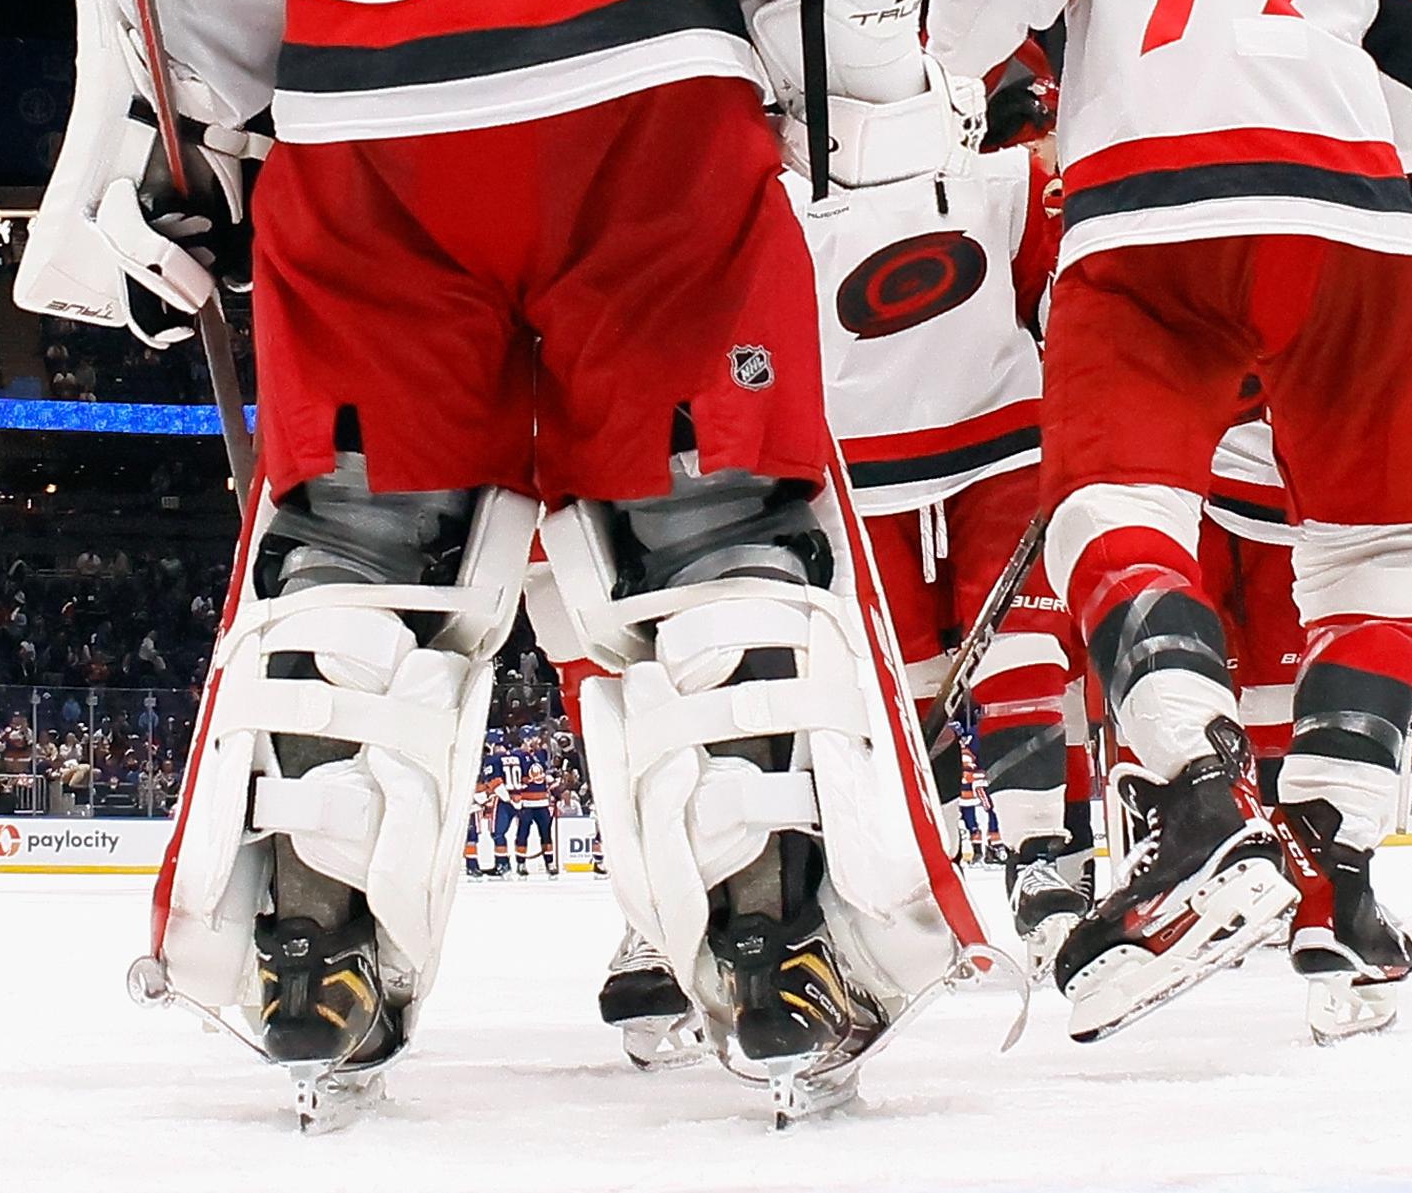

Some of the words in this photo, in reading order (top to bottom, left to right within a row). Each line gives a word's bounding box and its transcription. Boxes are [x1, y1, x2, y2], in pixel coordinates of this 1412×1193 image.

[740, 355, 765, 381] NHL
[1010, 595, 1066, 613] AUER
[27, 830, 120, 854] paylocity
[1276, 821, 1319, 878] CCM
